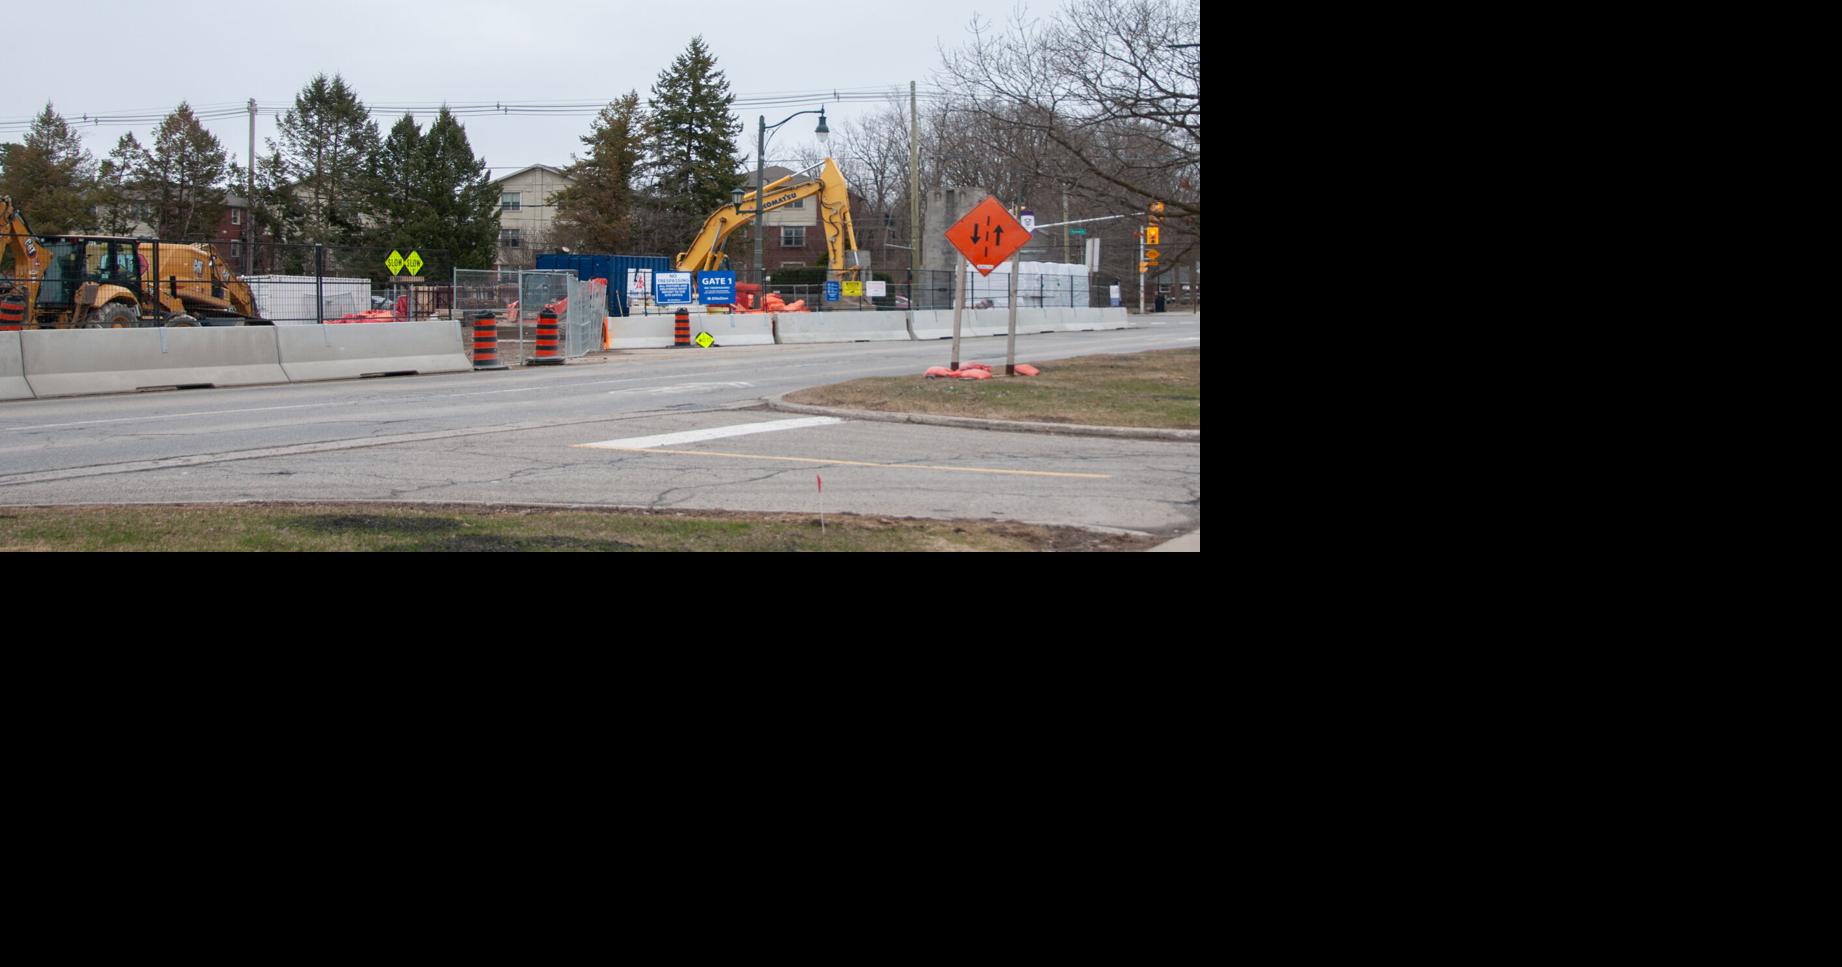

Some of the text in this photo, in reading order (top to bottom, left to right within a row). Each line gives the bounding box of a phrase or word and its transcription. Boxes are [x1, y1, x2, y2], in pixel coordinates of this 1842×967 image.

[763, 192, 797, 208] KOMATSU
[702, 277, 732, 285] GATE 1
